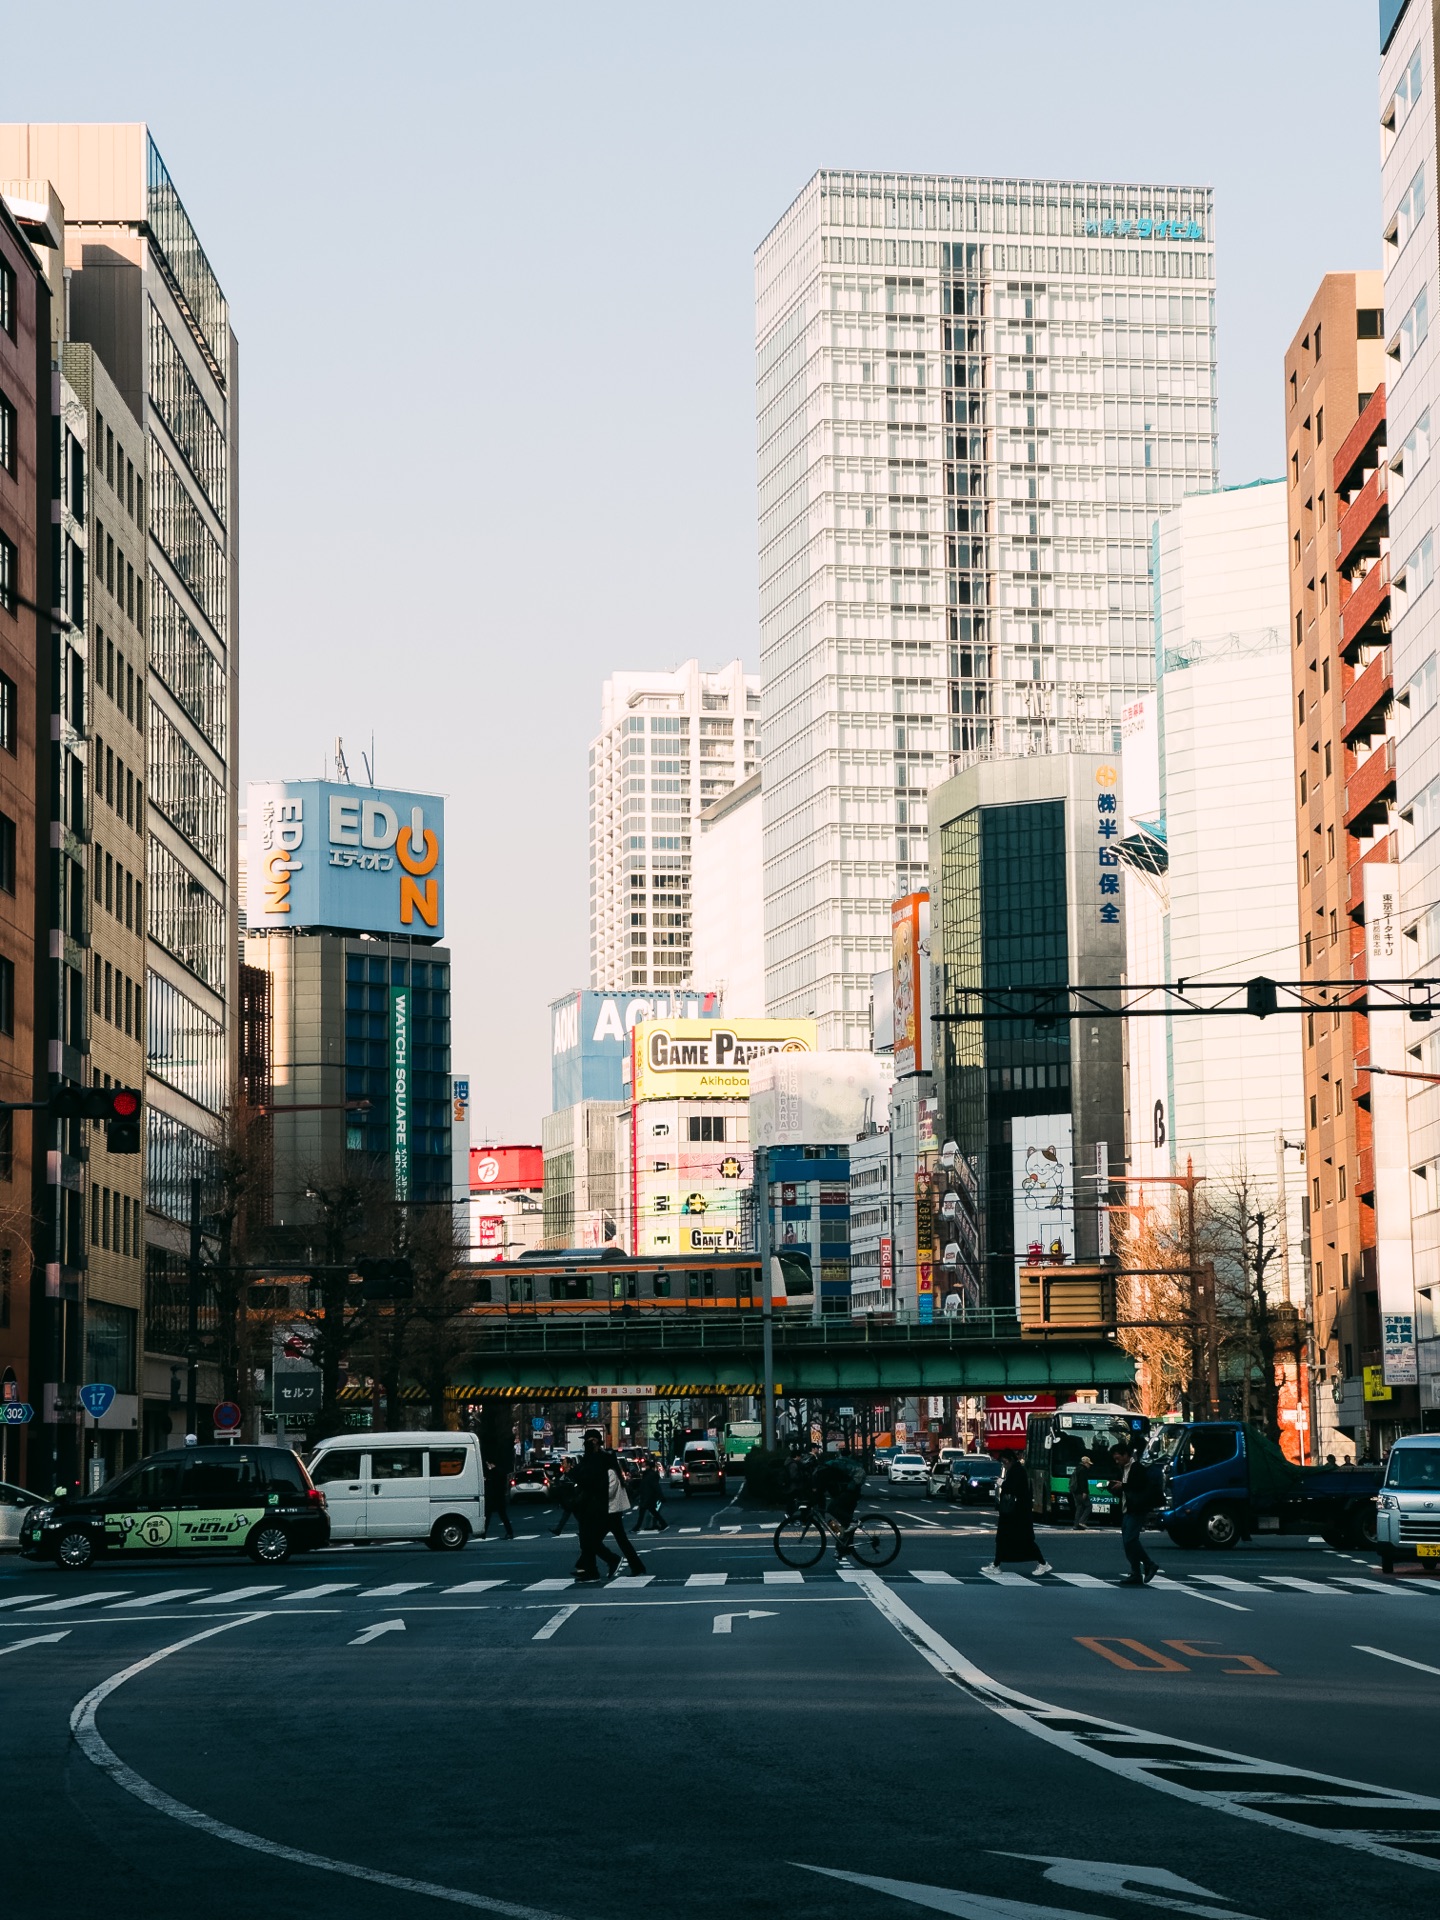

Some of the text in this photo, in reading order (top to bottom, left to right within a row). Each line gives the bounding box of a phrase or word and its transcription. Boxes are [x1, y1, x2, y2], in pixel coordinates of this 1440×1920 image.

[329, 850, 394, 871] エディオン
[553, 1002, 578, 1055] AOKI
[395, 994, 407, 1146] WATCH SQUARE
[882, 1244, 891, 1280] FIGURE
[90, 1393, 106, 1406] 17
[281, 1387, 315, 1399] セルフ
[6, 1408, 23, 1419] 302
